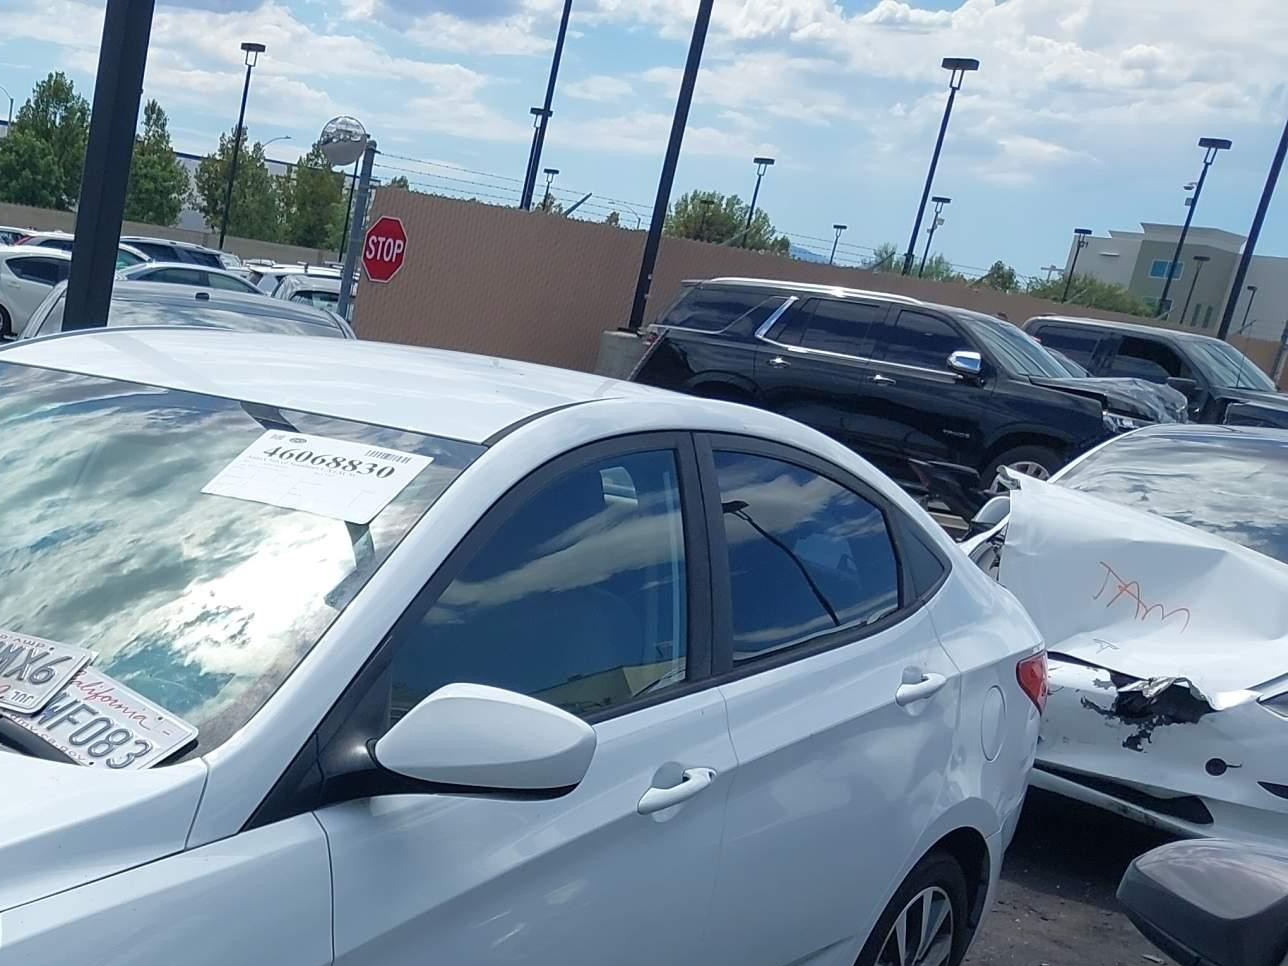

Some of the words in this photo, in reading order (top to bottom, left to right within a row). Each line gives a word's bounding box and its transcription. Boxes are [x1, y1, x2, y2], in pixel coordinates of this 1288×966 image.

[366, 235, 404, 263] STOP
[264, 446, 395, 479] 46068830
[10, 690, 34, 704] JUL
[37, 692, 154, 770] WF083
